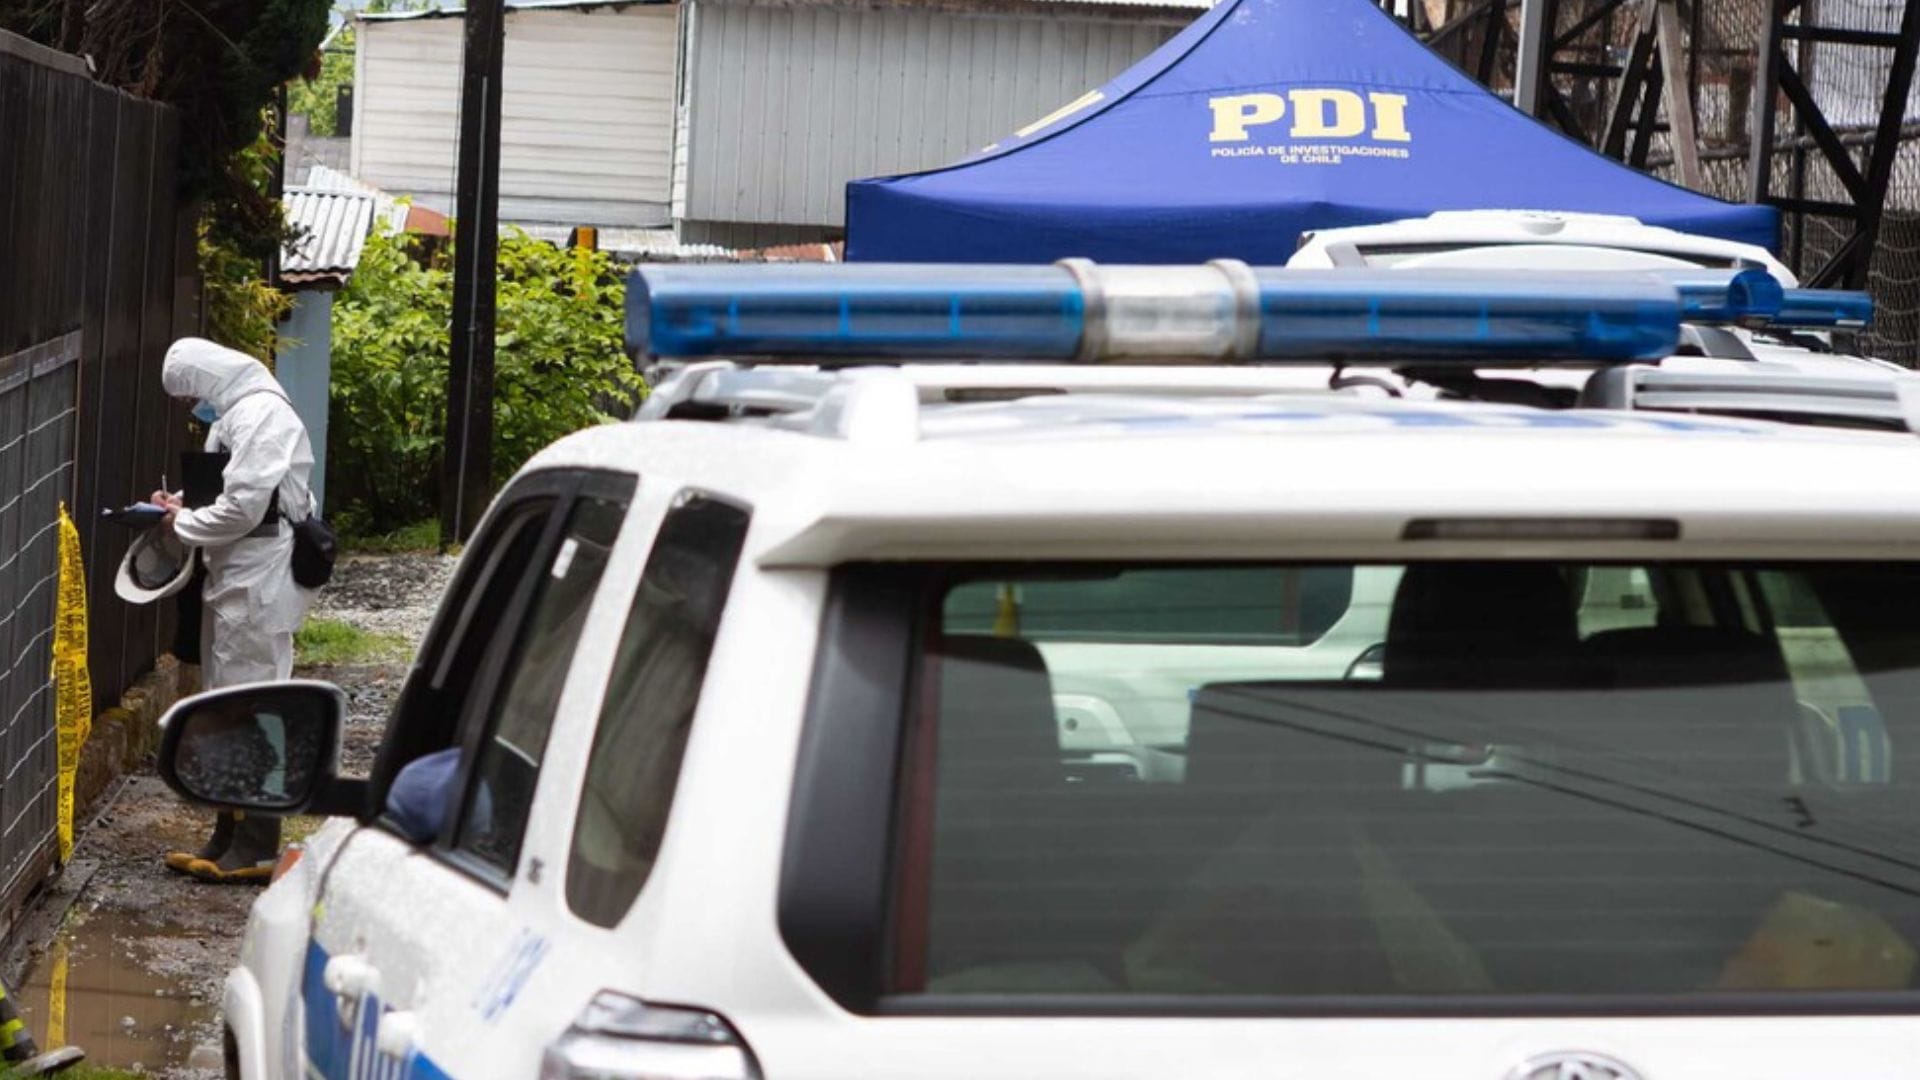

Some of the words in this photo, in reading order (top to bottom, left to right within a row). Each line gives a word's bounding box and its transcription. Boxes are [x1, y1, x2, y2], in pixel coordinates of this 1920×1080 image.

[1208, 88, 1412, 142] PDI
[1212, 146, 1263, 157] POLICÍA
[1268, 146, 1286, 156] DE
[1291, 146, 1409, 158] INVESTIGACIONES
[1280, 155, 1299, 164] DE
[1303, 155, 1341, 164] CHILE
